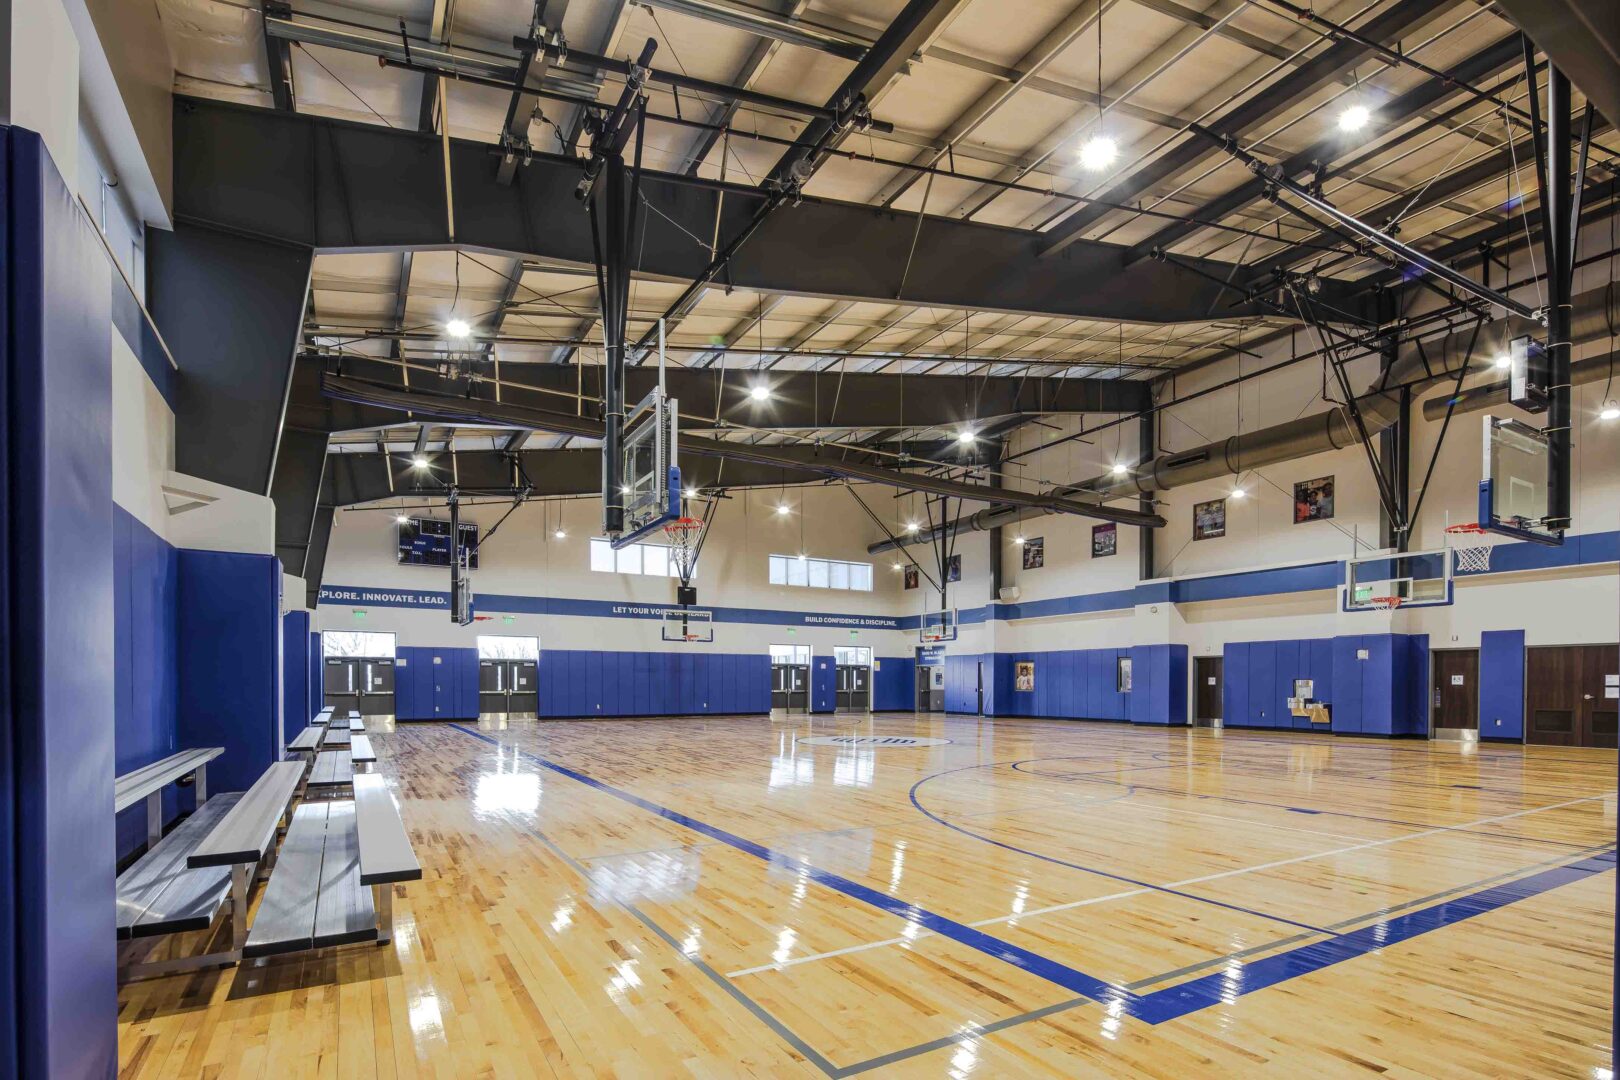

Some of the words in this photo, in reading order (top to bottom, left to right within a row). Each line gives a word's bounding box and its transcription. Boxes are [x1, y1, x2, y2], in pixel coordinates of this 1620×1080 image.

[362, 592, 417, 603] INNOVATE.
[418, 595, 447, 605] LEAD.
[612, 606, 626, 614] LET
[627, 607, 649, 615] YOUR
[824, 617, 859, 625] CONFIDENCE
